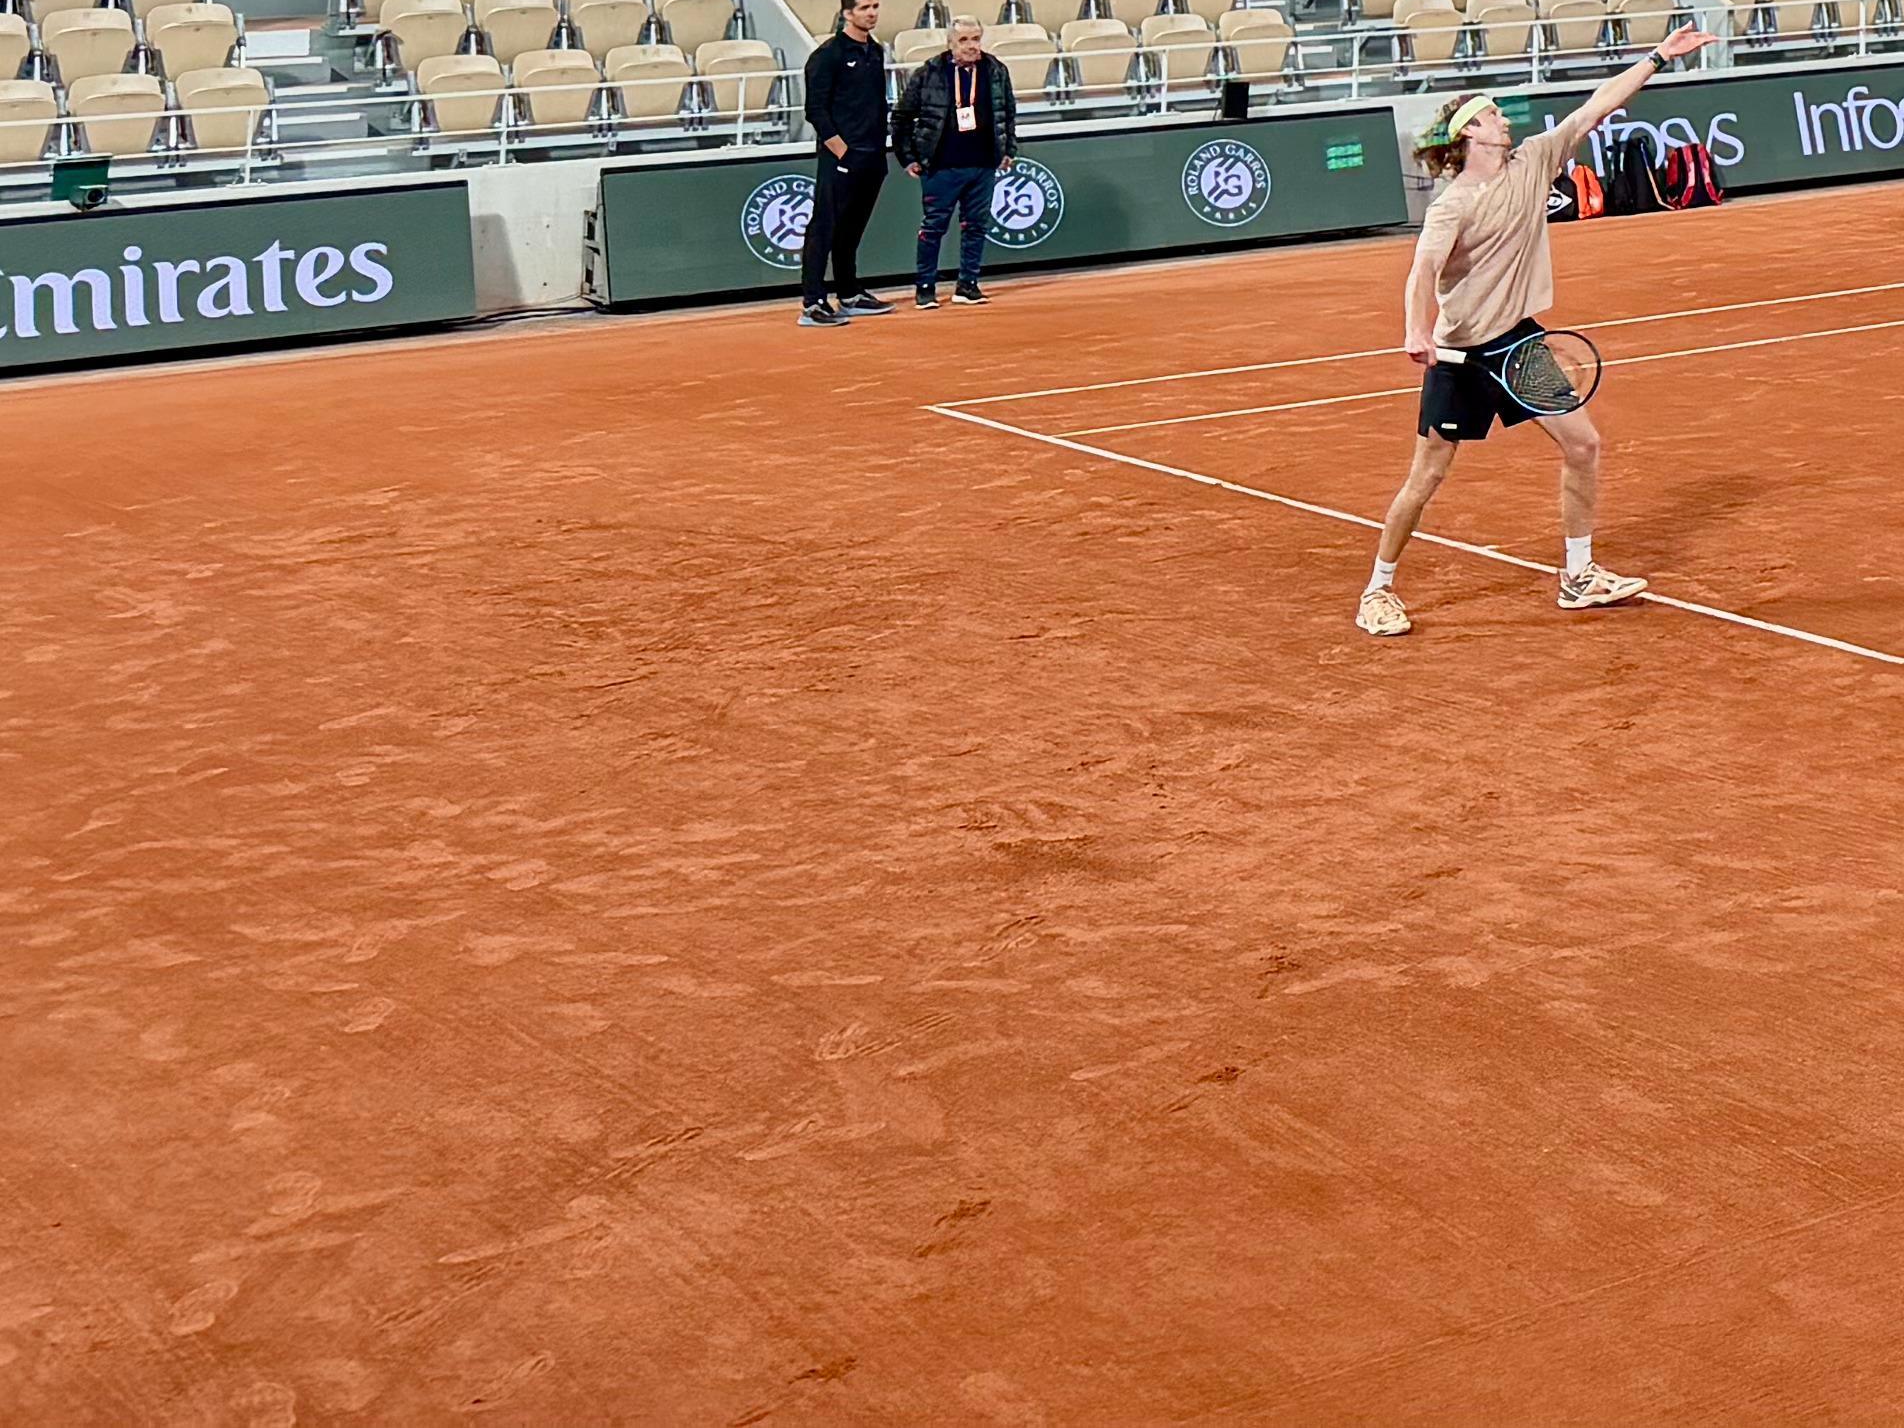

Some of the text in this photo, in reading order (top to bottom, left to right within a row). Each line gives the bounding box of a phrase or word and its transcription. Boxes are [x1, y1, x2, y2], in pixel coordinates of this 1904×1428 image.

[1187, 144, 1266, 195] ROLAND GARROS
[747, 181, 788, 236] ROLAND
[0, 239, 394, 339] mirates
